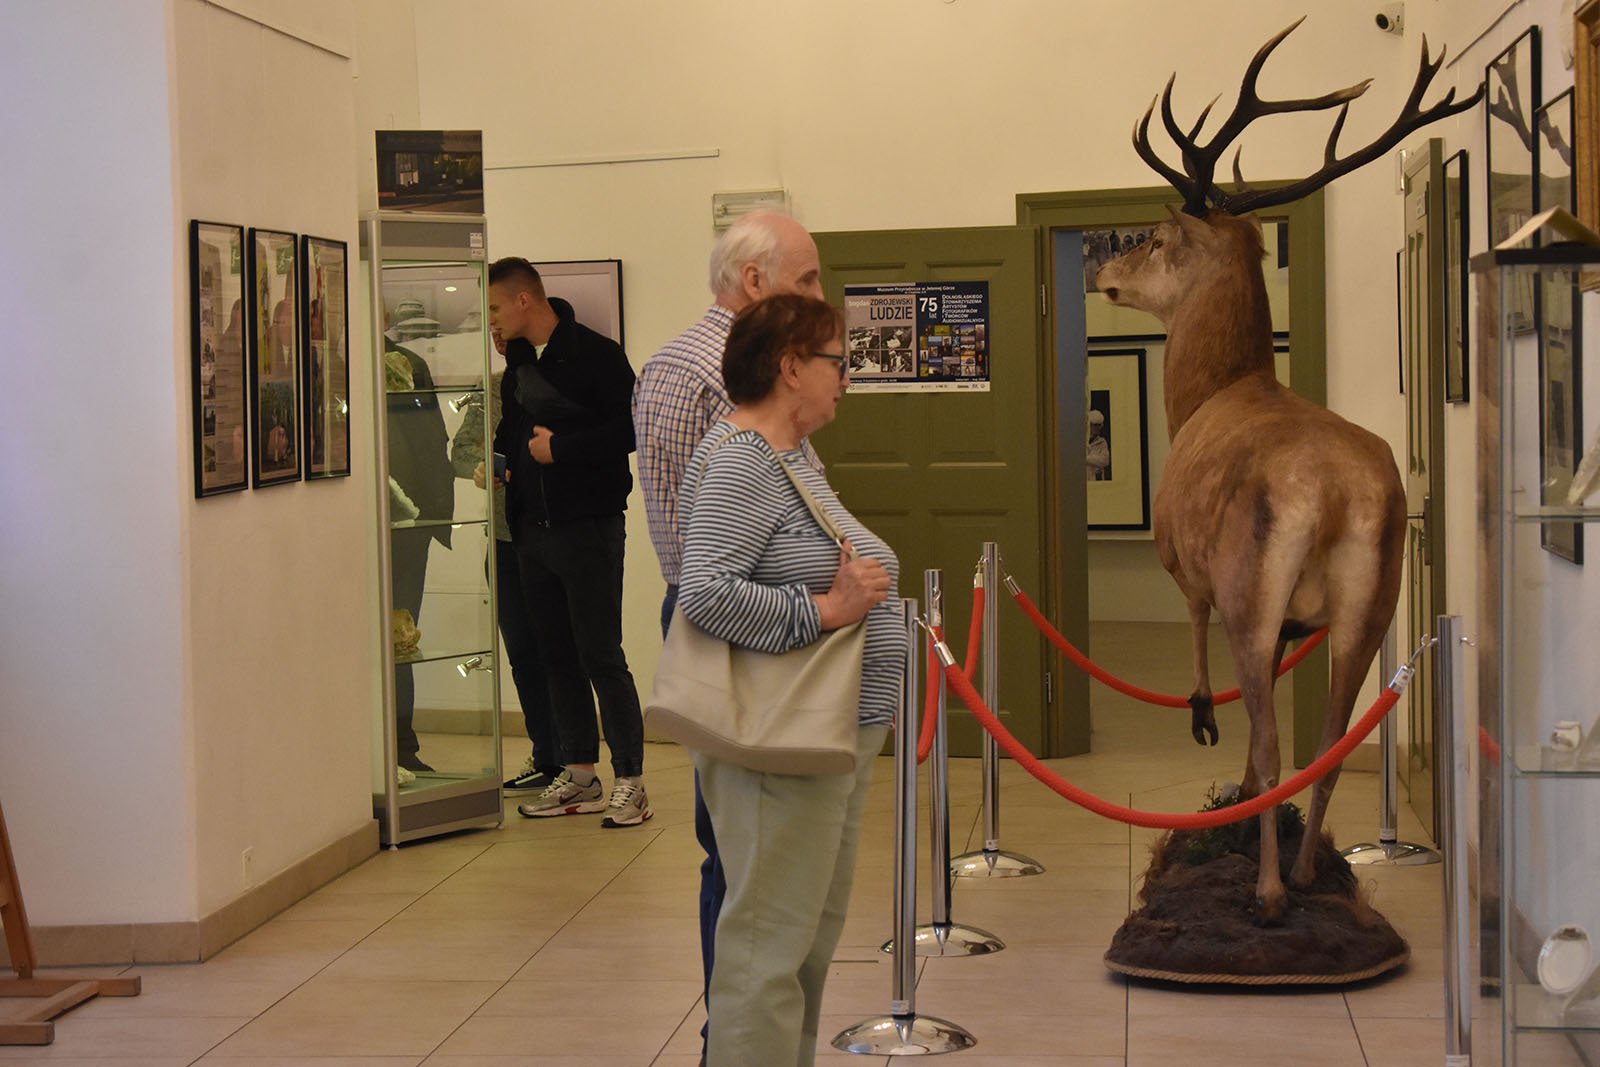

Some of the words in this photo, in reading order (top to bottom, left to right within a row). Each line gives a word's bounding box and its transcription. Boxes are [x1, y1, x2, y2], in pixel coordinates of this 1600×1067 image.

[870, 298, 913, 306] ZDROJEWSKI
[919, 297, 938, 313] 75
[870, 306, 913, 320] LUDZIE
